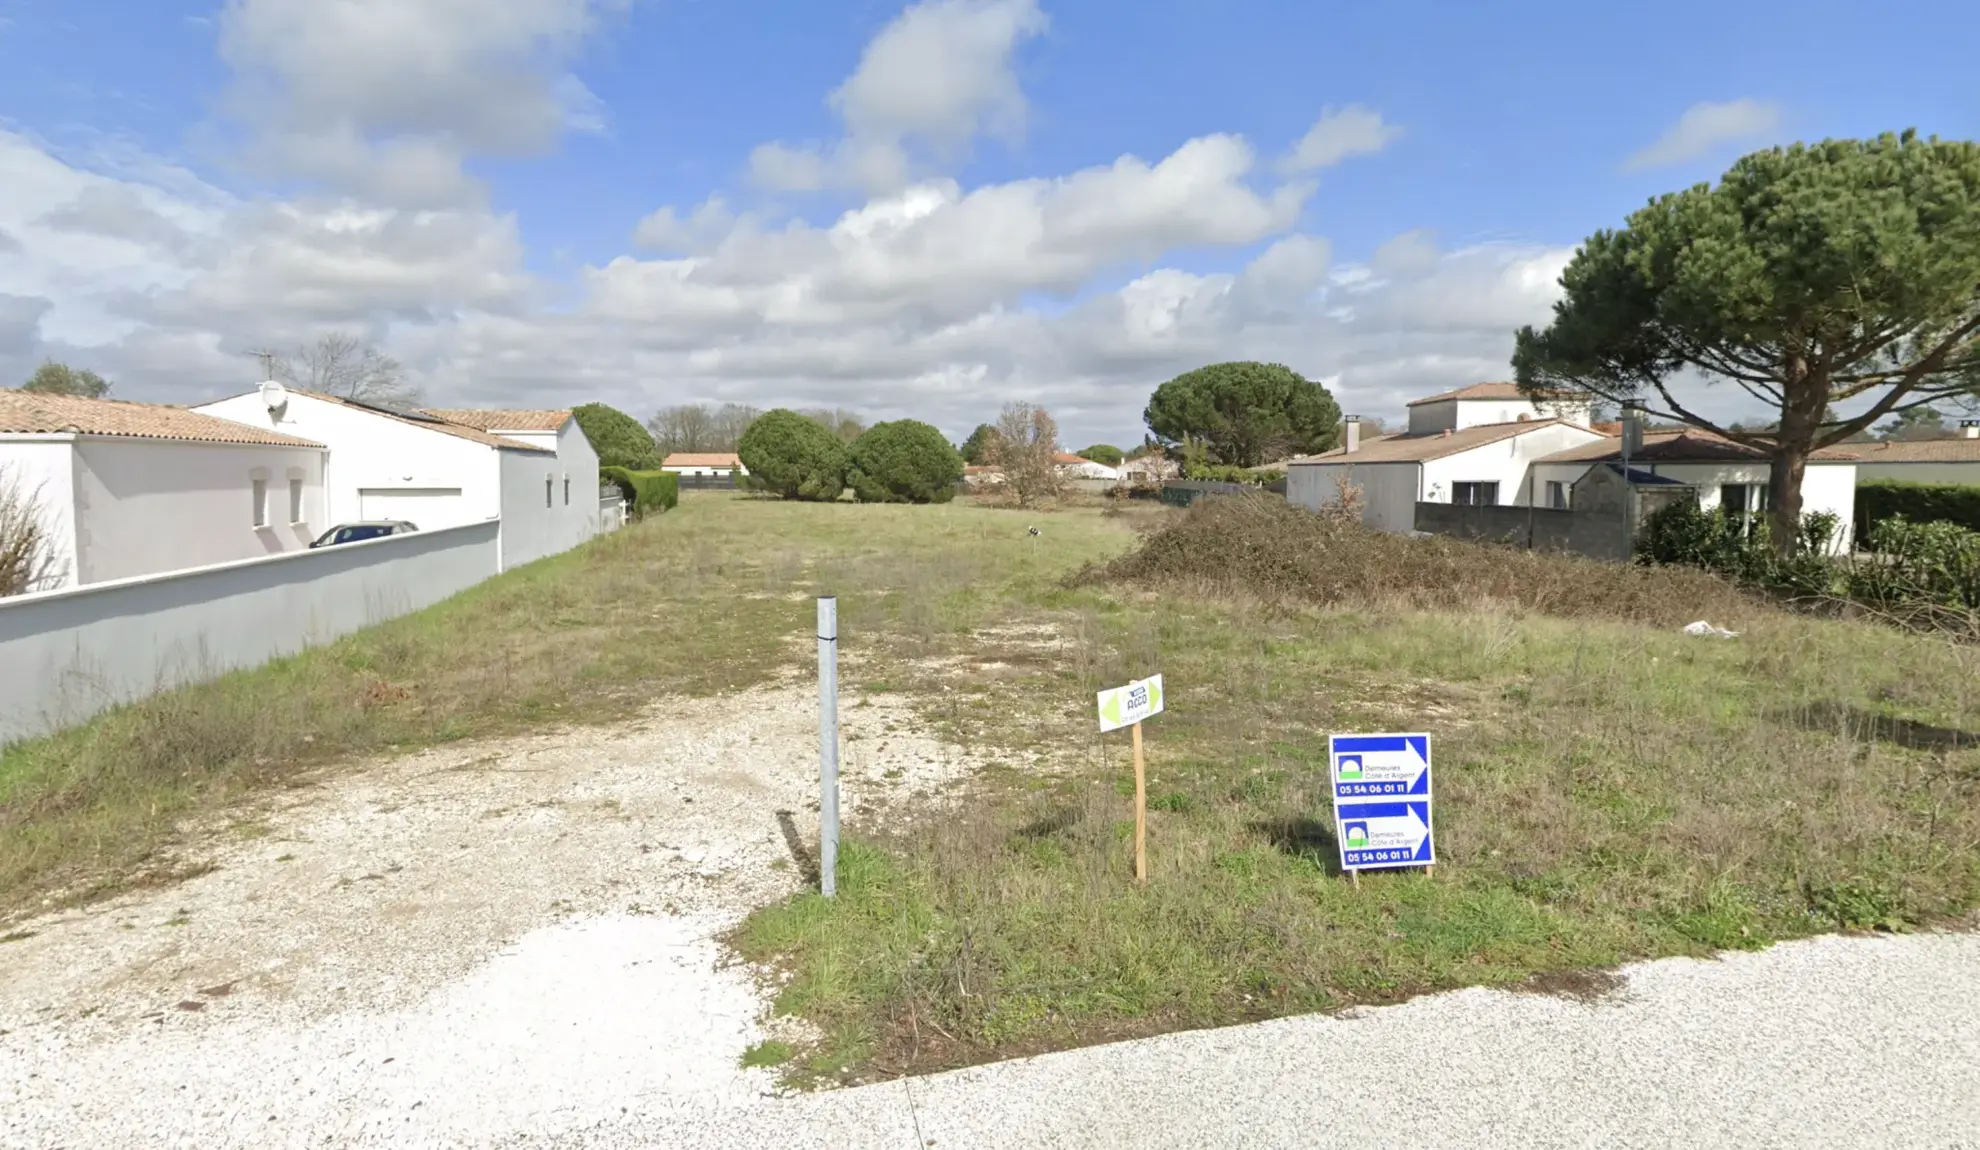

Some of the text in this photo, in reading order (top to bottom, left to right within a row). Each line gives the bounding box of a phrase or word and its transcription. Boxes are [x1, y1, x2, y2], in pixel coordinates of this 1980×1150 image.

[1340, 784, 1404, 794] 05 54 06 01 11
[1348, 851, 1409, 862] 05 54 06 01 11
